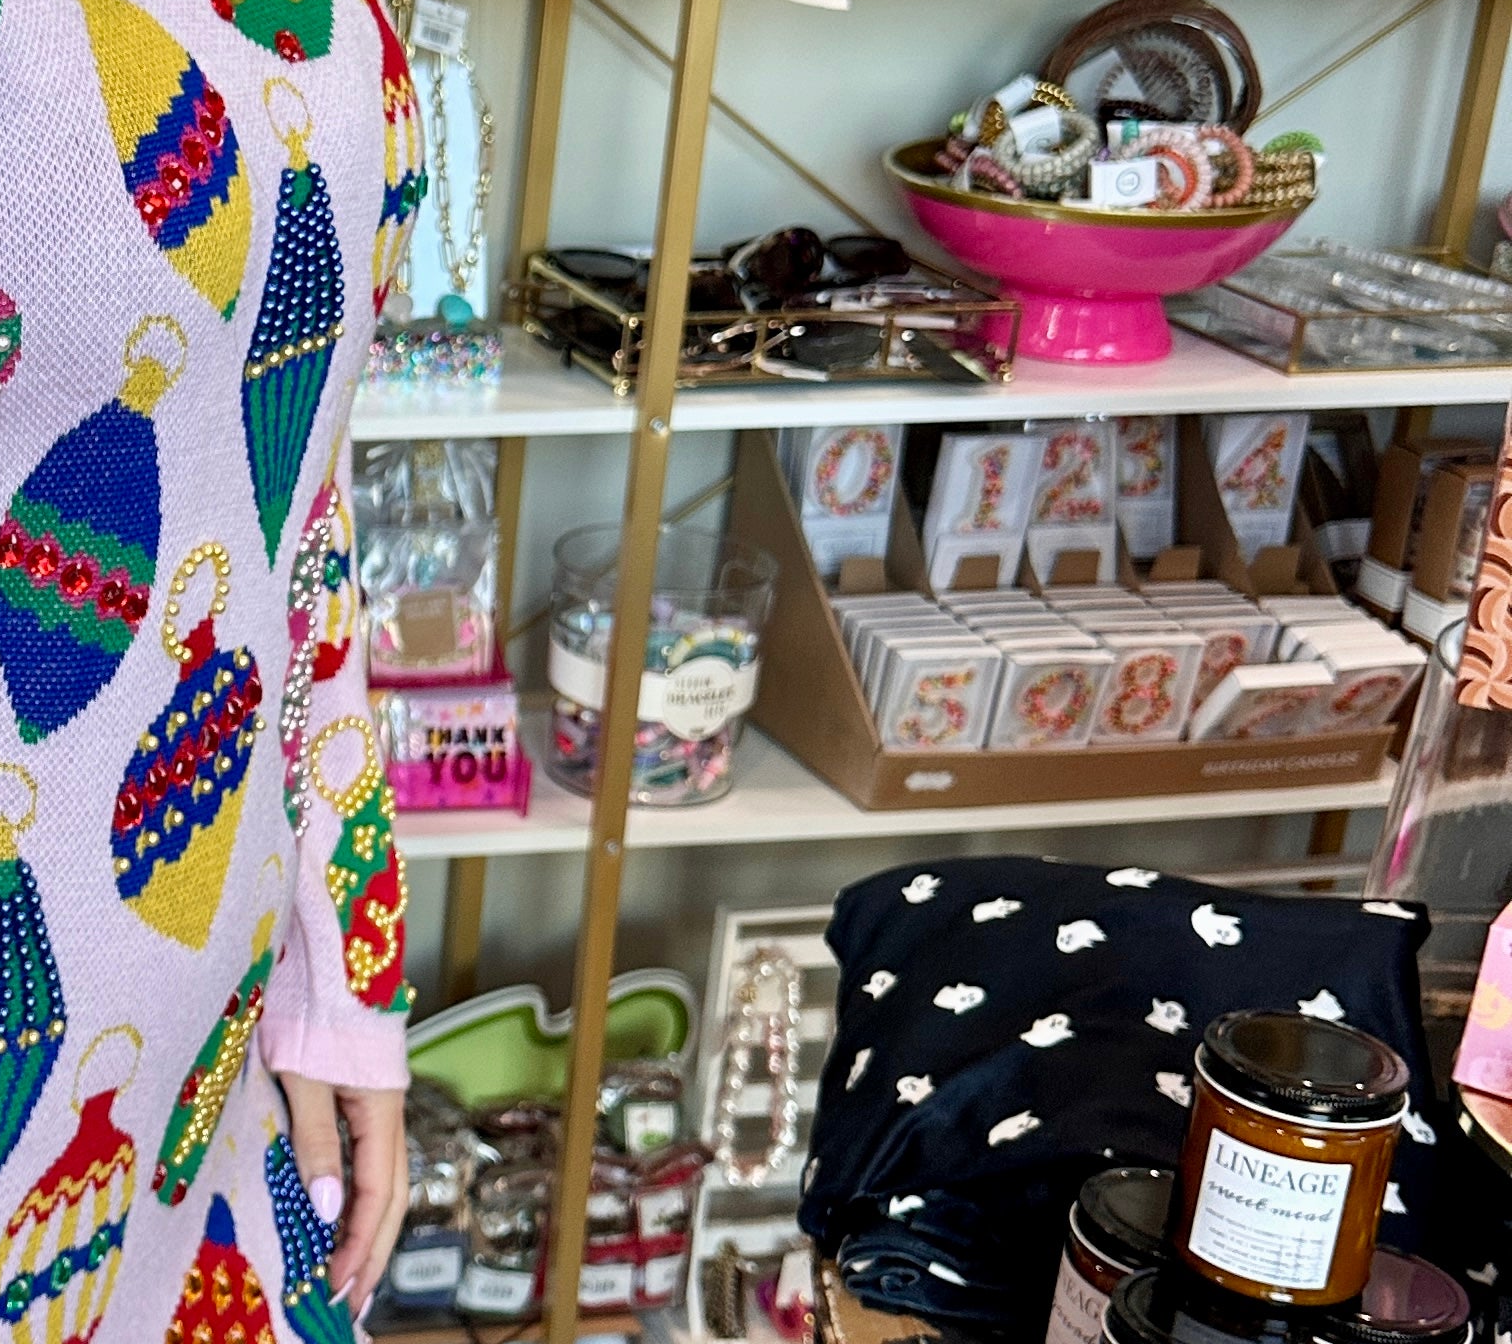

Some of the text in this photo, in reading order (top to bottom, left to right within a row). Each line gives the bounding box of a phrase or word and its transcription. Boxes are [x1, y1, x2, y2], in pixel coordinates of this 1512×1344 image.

[426, 727, 505, 745] THANK
[424, 752, 507, 785] YOU
[1214, 1142, 1341, 1196] LINEAGE
[1207, 1180, 1335, 1223] sweet mead
